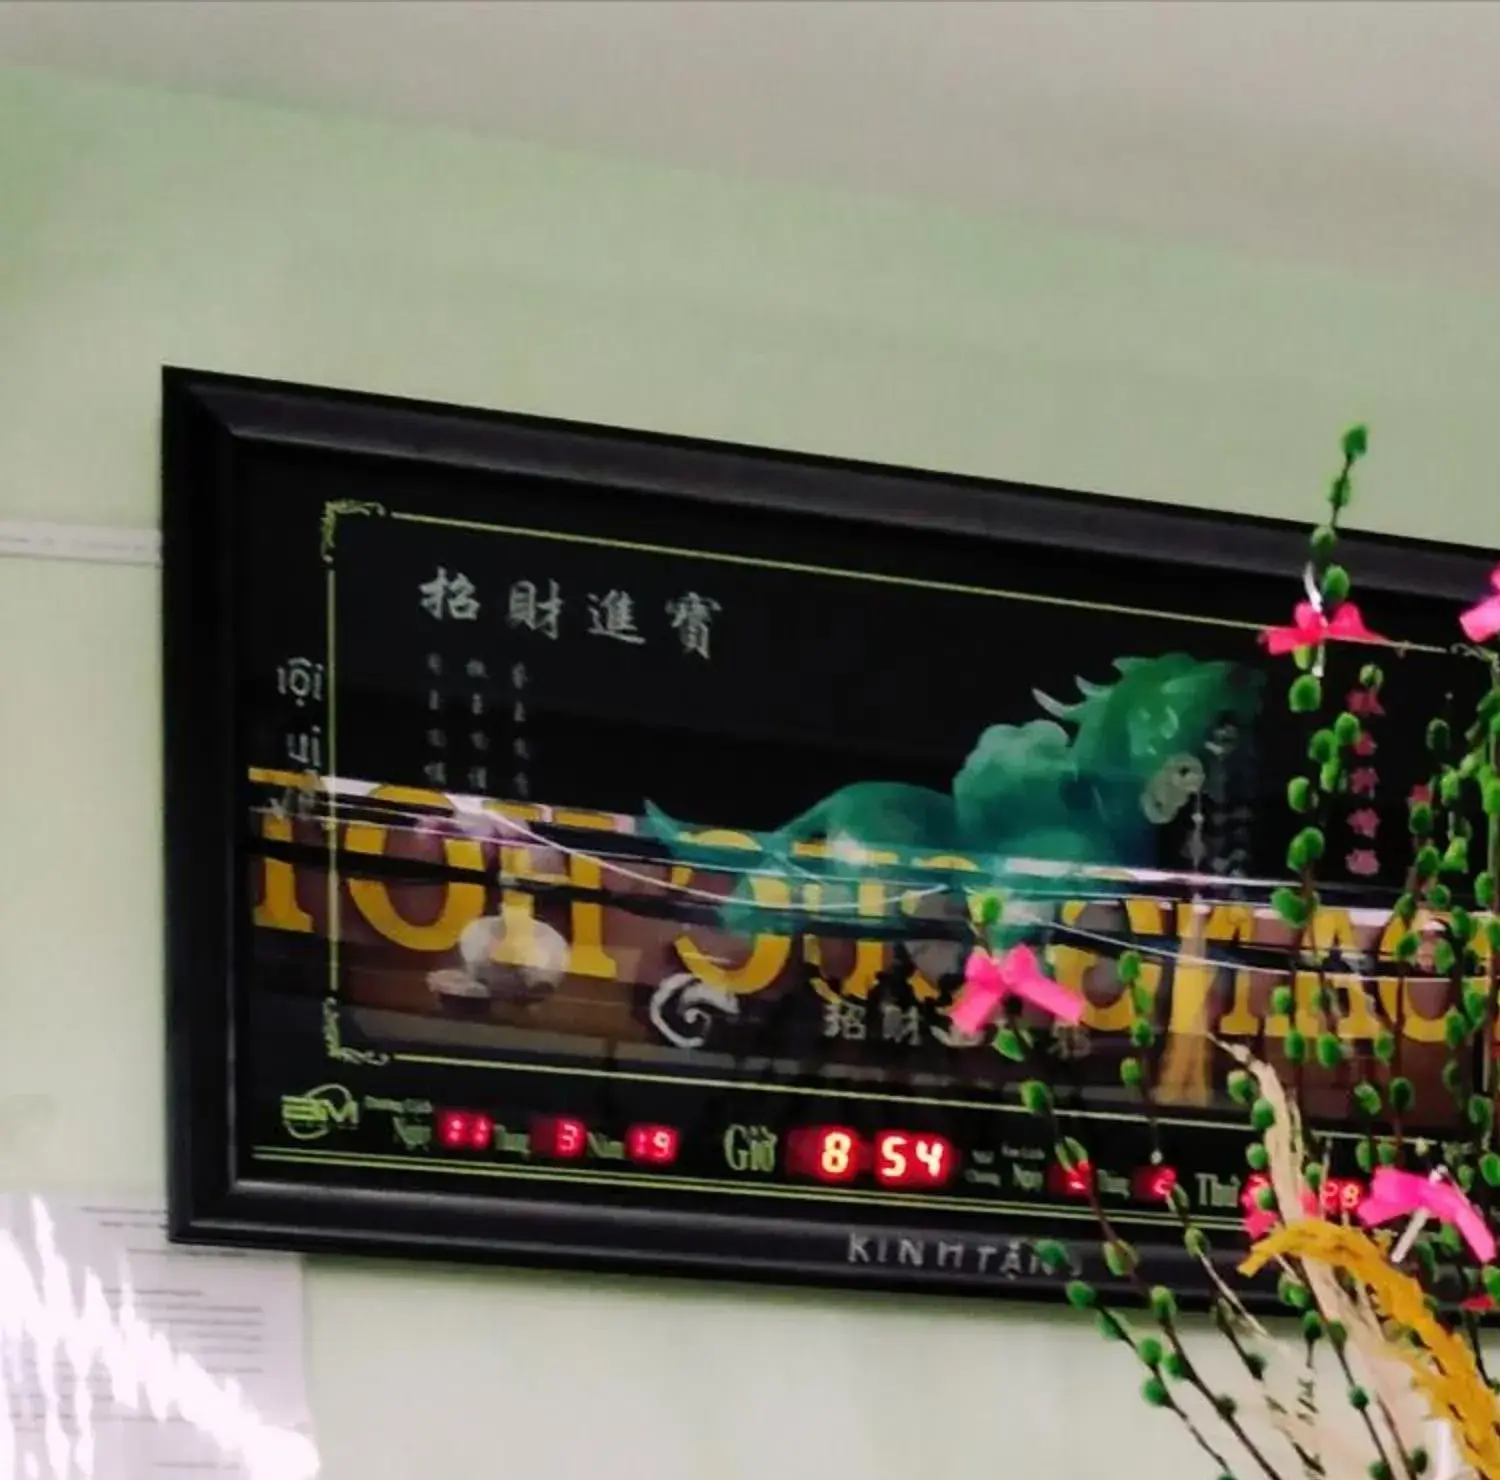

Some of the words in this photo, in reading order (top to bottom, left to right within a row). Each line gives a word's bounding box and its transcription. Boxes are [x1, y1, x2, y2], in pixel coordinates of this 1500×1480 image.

[418, 566, 723, 659] 招財進寶
[819, 1131, 853, 1175] 8
[881, 1135, 945, 1179] 54
